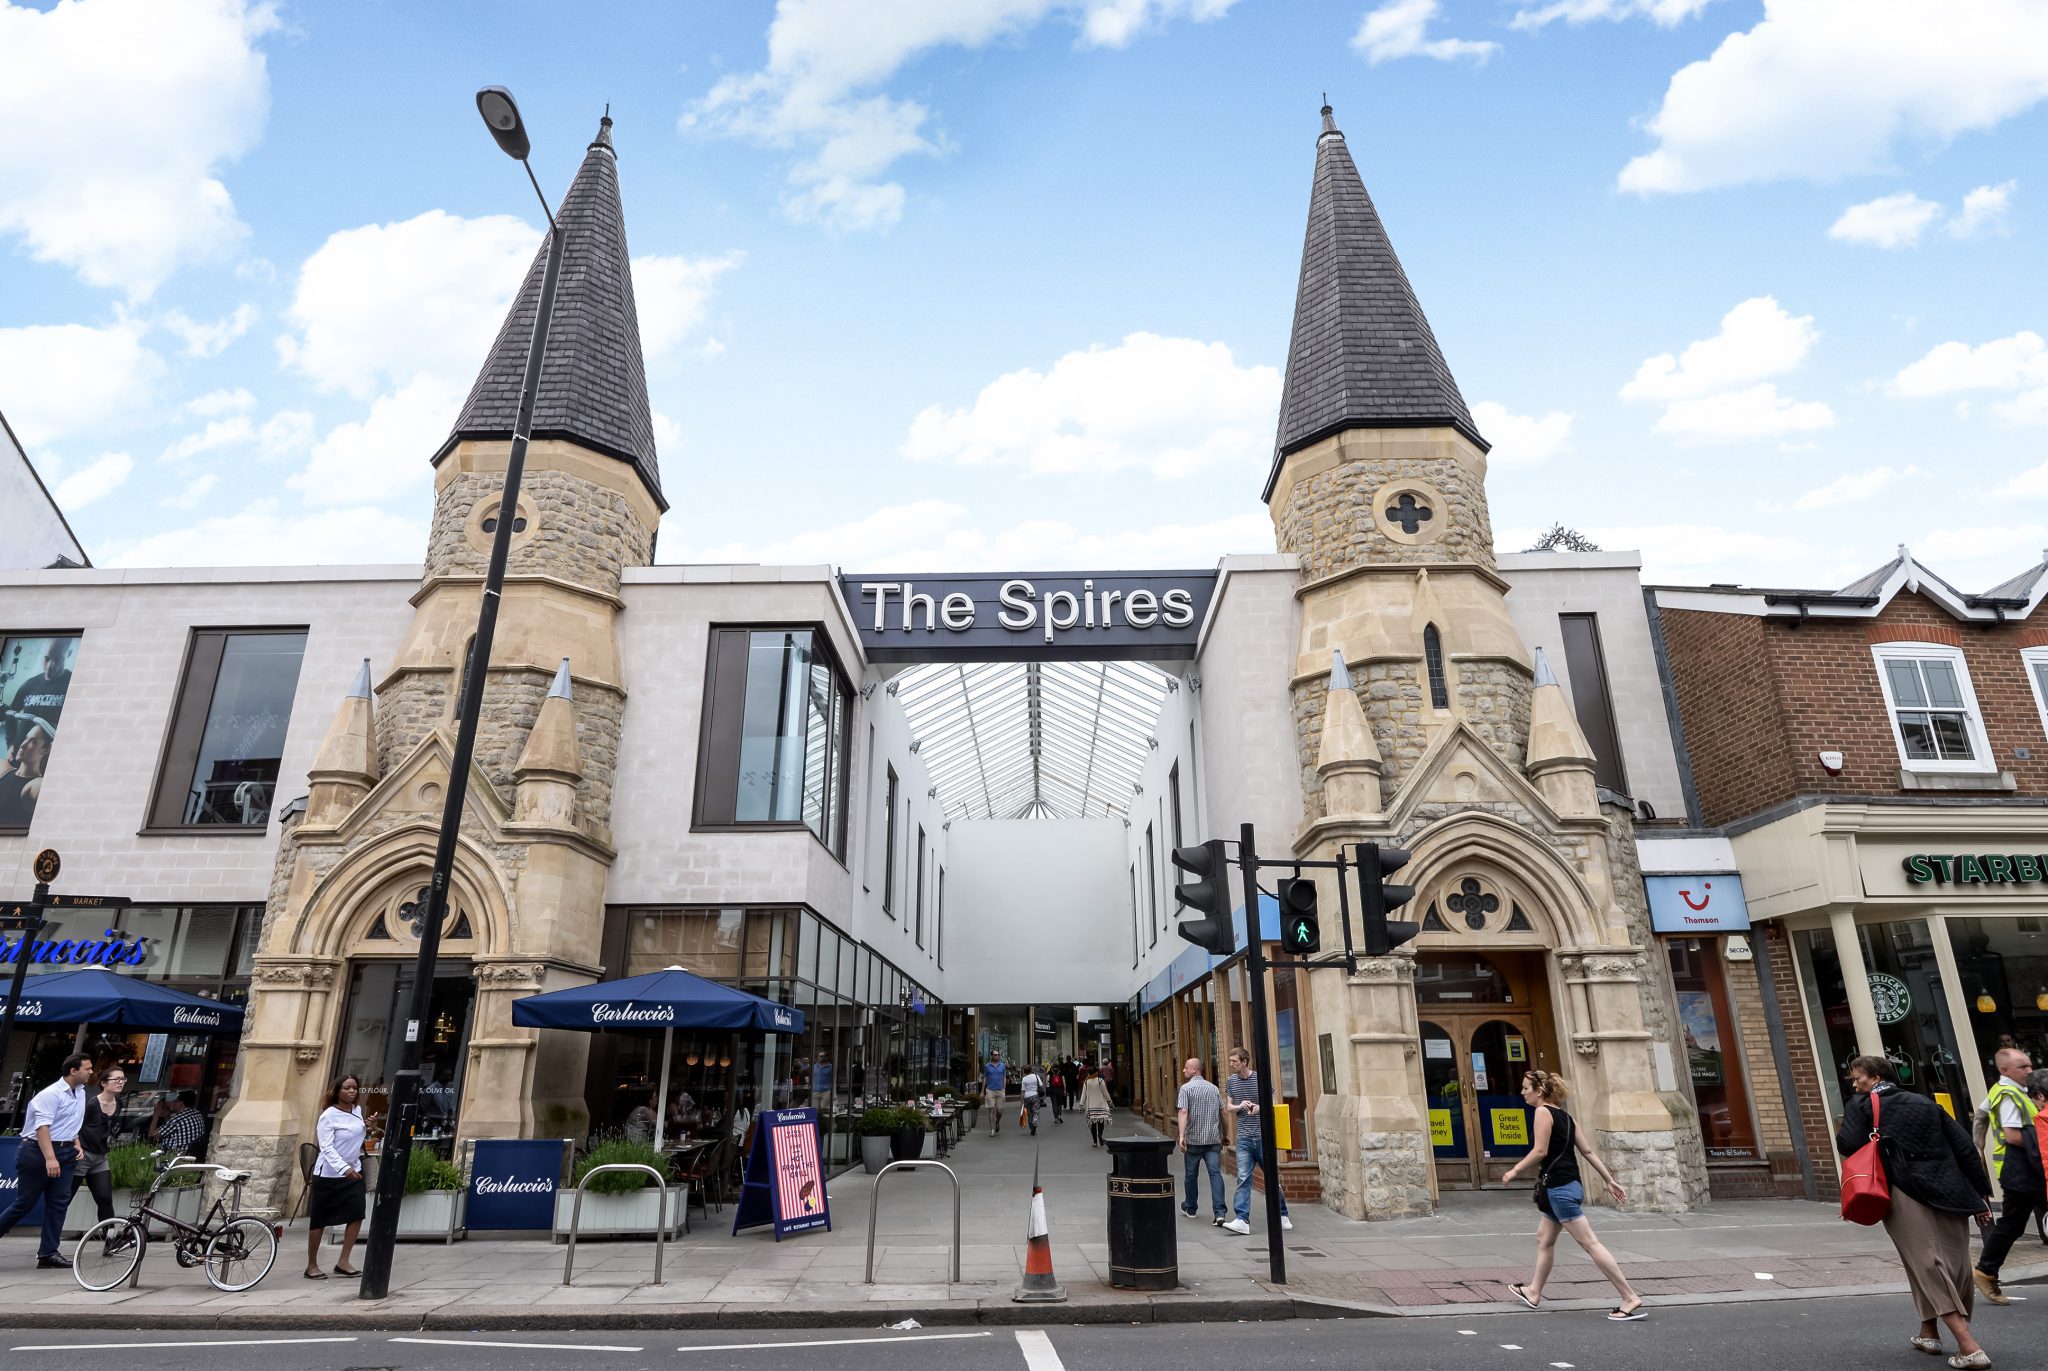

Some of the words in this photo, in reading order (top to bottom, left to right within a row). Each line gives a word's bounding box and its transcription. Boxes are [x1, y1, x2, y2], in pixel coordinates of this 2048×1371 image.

[861, 582, 975, 632] The
[998, 580, 1194, 644] Spires
[73, 897, 104, 906] MARKET
[1683, 916, 1719, 924] Thomson
[174, 1006, 221, 1026] Carluccio's
[591, 1002, 675, 1023] Carluccio's
[1498, 1114, 1519, 1123] Great
[1499, 1123, 1520, 1131] Rates
[1500, 1131, 1522, 1140] Inside
[475, 1175, 553, 1195] Carluccio's
